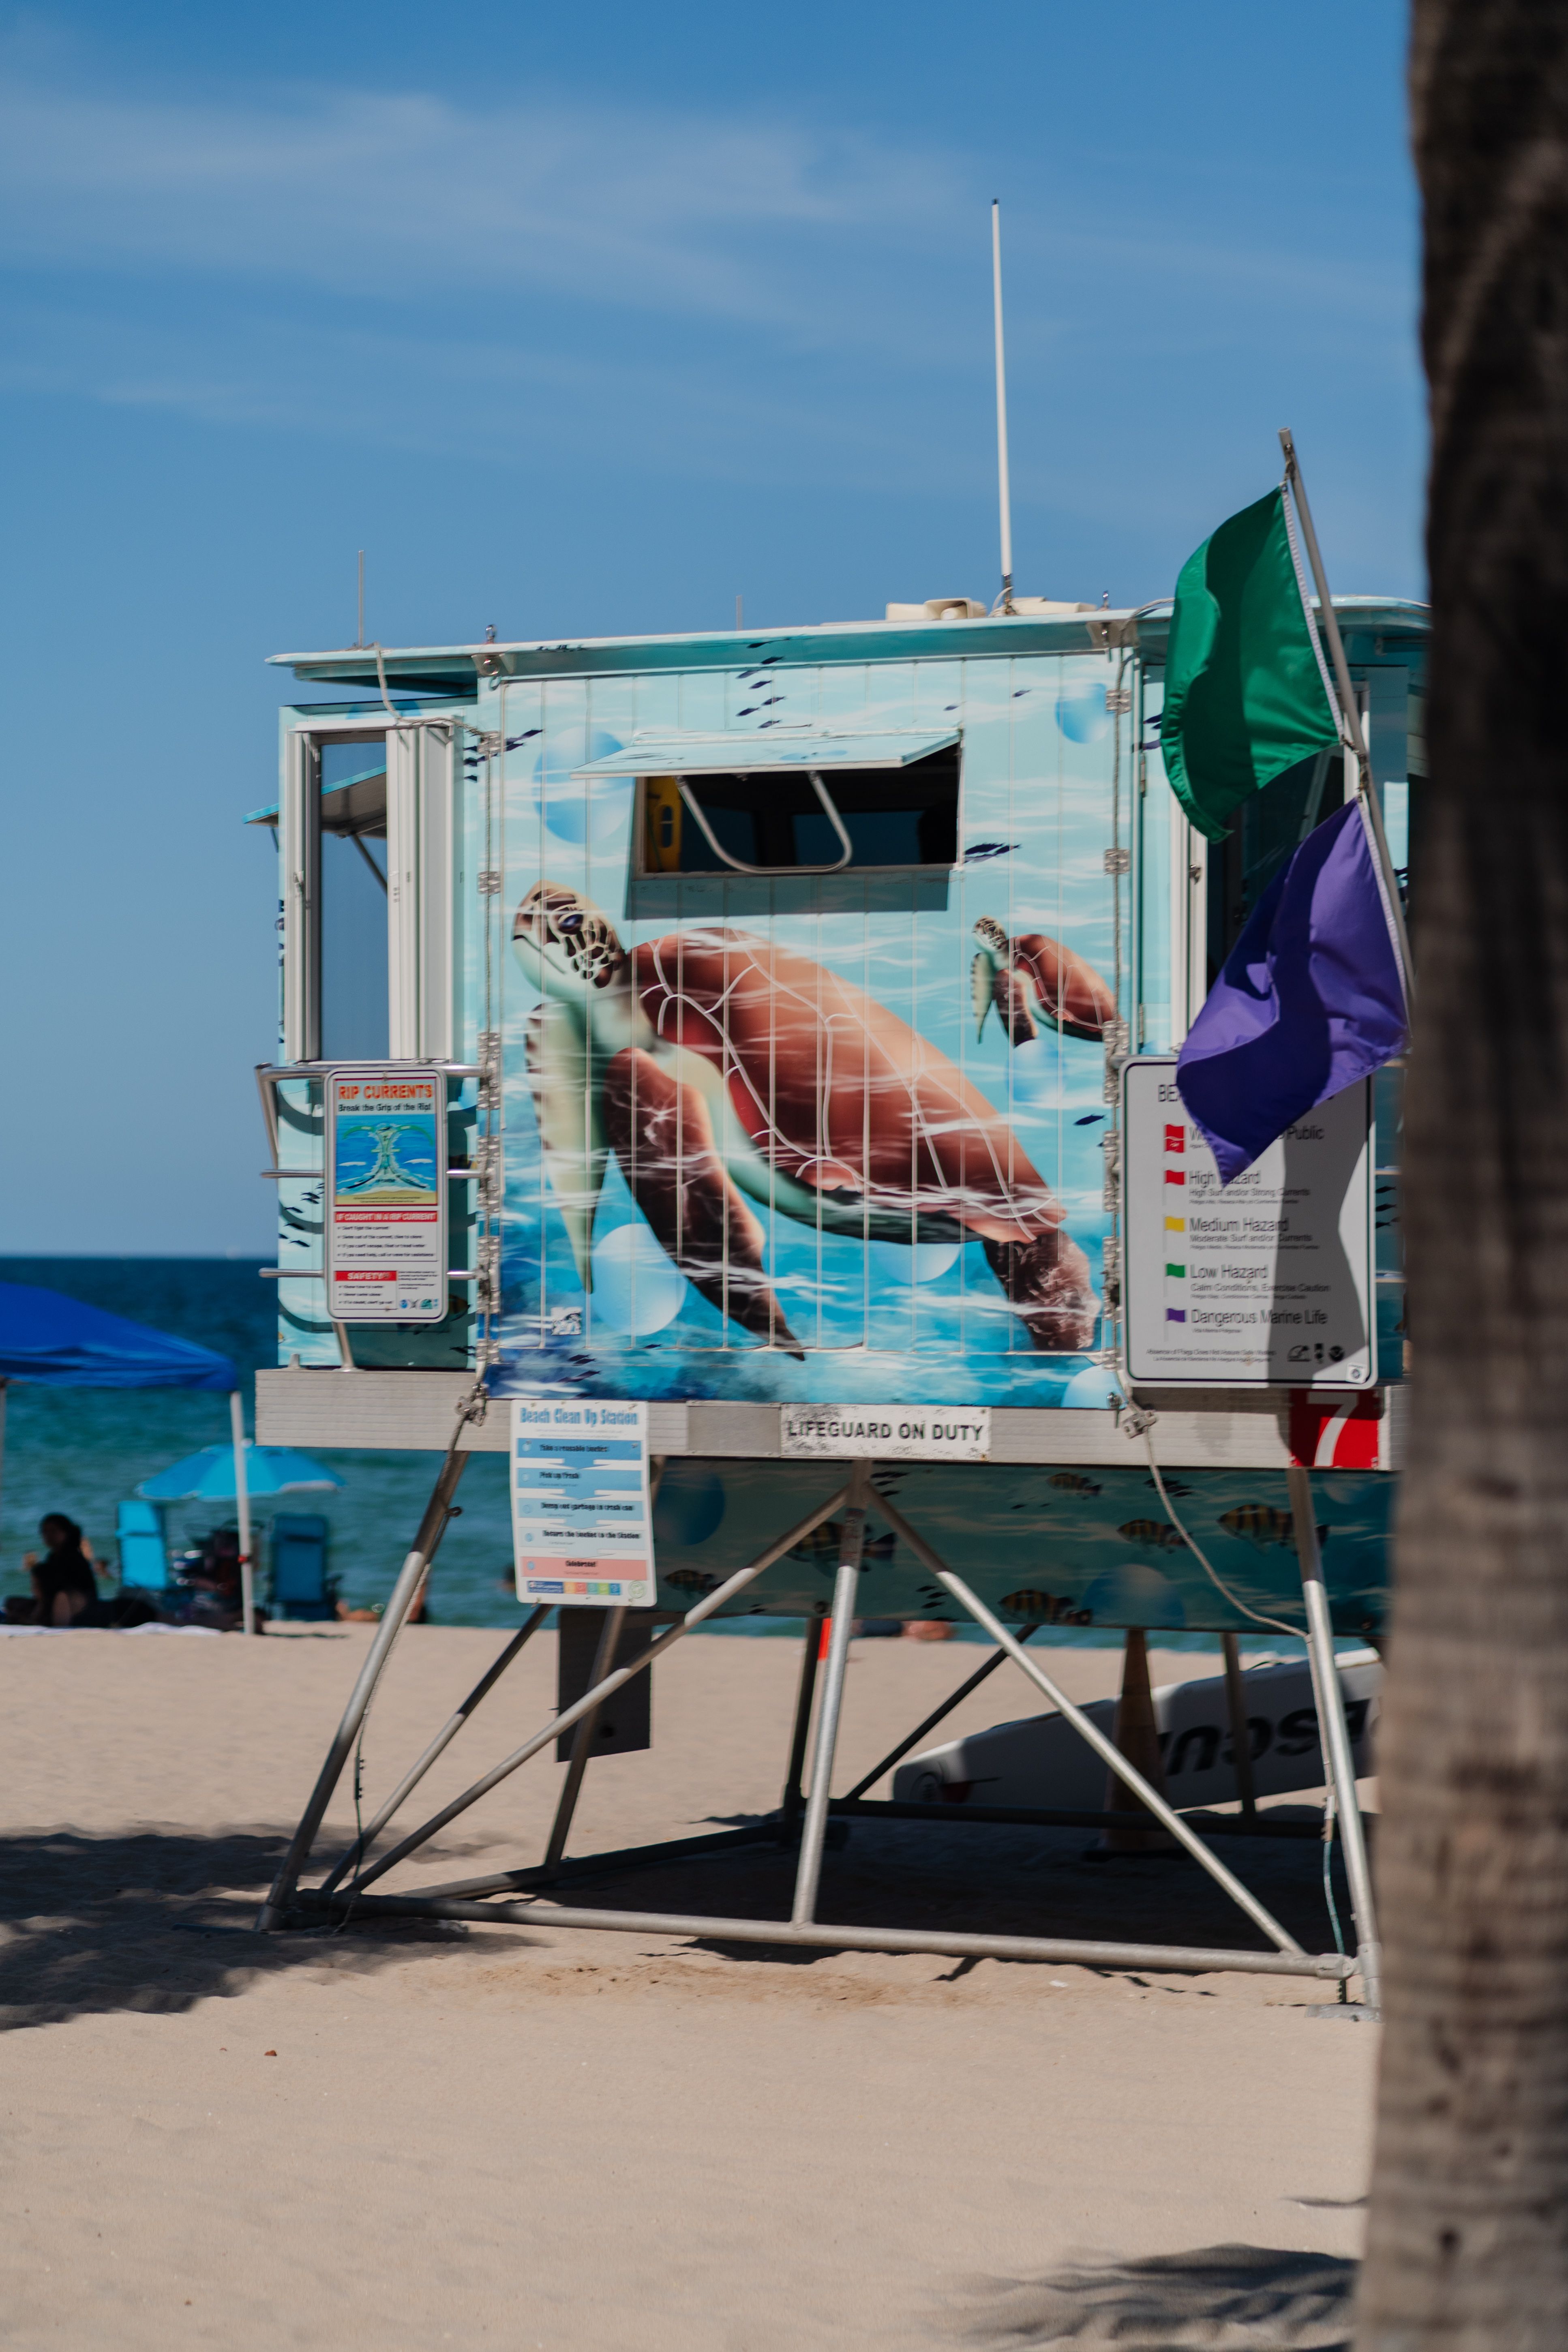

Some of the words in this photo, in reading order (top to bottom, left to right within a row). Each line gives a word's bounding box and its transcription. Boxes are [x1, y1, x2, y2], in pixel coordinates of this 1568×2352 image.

[338, 1086, 359, 1099] RIP
[364, 1084, 433, 1099] CURRENTS
[376, 1103, 391, 1112] Grip
[1286, 1125, 1324, 1140] Public
[1189, 1171, 1215, 1188] High
[1219, 1170, 1261, 1184] zard
[1189, 1189, 1206, 1198] High
[1251, 1189, 1275, 1197] Strong
[1189, 1218, 1239, 1232] Medium
[1243, 1218, 1289, 1232] Hazard
[1191, 1264, 1217, 1278] Low
[1221, 1264, 1268, 1278] Hazard
[1191, 1283, 1211, 1292] Calm
[1262, 1283, 1296, 1292] Exercise
[1298, 1283, 1330, 1292] Caution
[1191, 1309, 1256, 1326] Dangerous
[1260, 1309, 1302, 1324] Marine
[1305, 1309, 1328, 1324] Life
[520, 1408, 550, 1423] Beach
[555, 1408, 581, 1424] Clean
[584, 1409, 597, 1427] Up
[601, 1409, 638, 1425] Station
[788, 1420, 891, 1438] LIFEGUARD
[899, 1423, 925, 1439] ON
[932, 1424, 983, 1441] DUTY
[1306, 1391, 1359, 1467] 7
[1158, 1700, 1369, 1776] SCU
